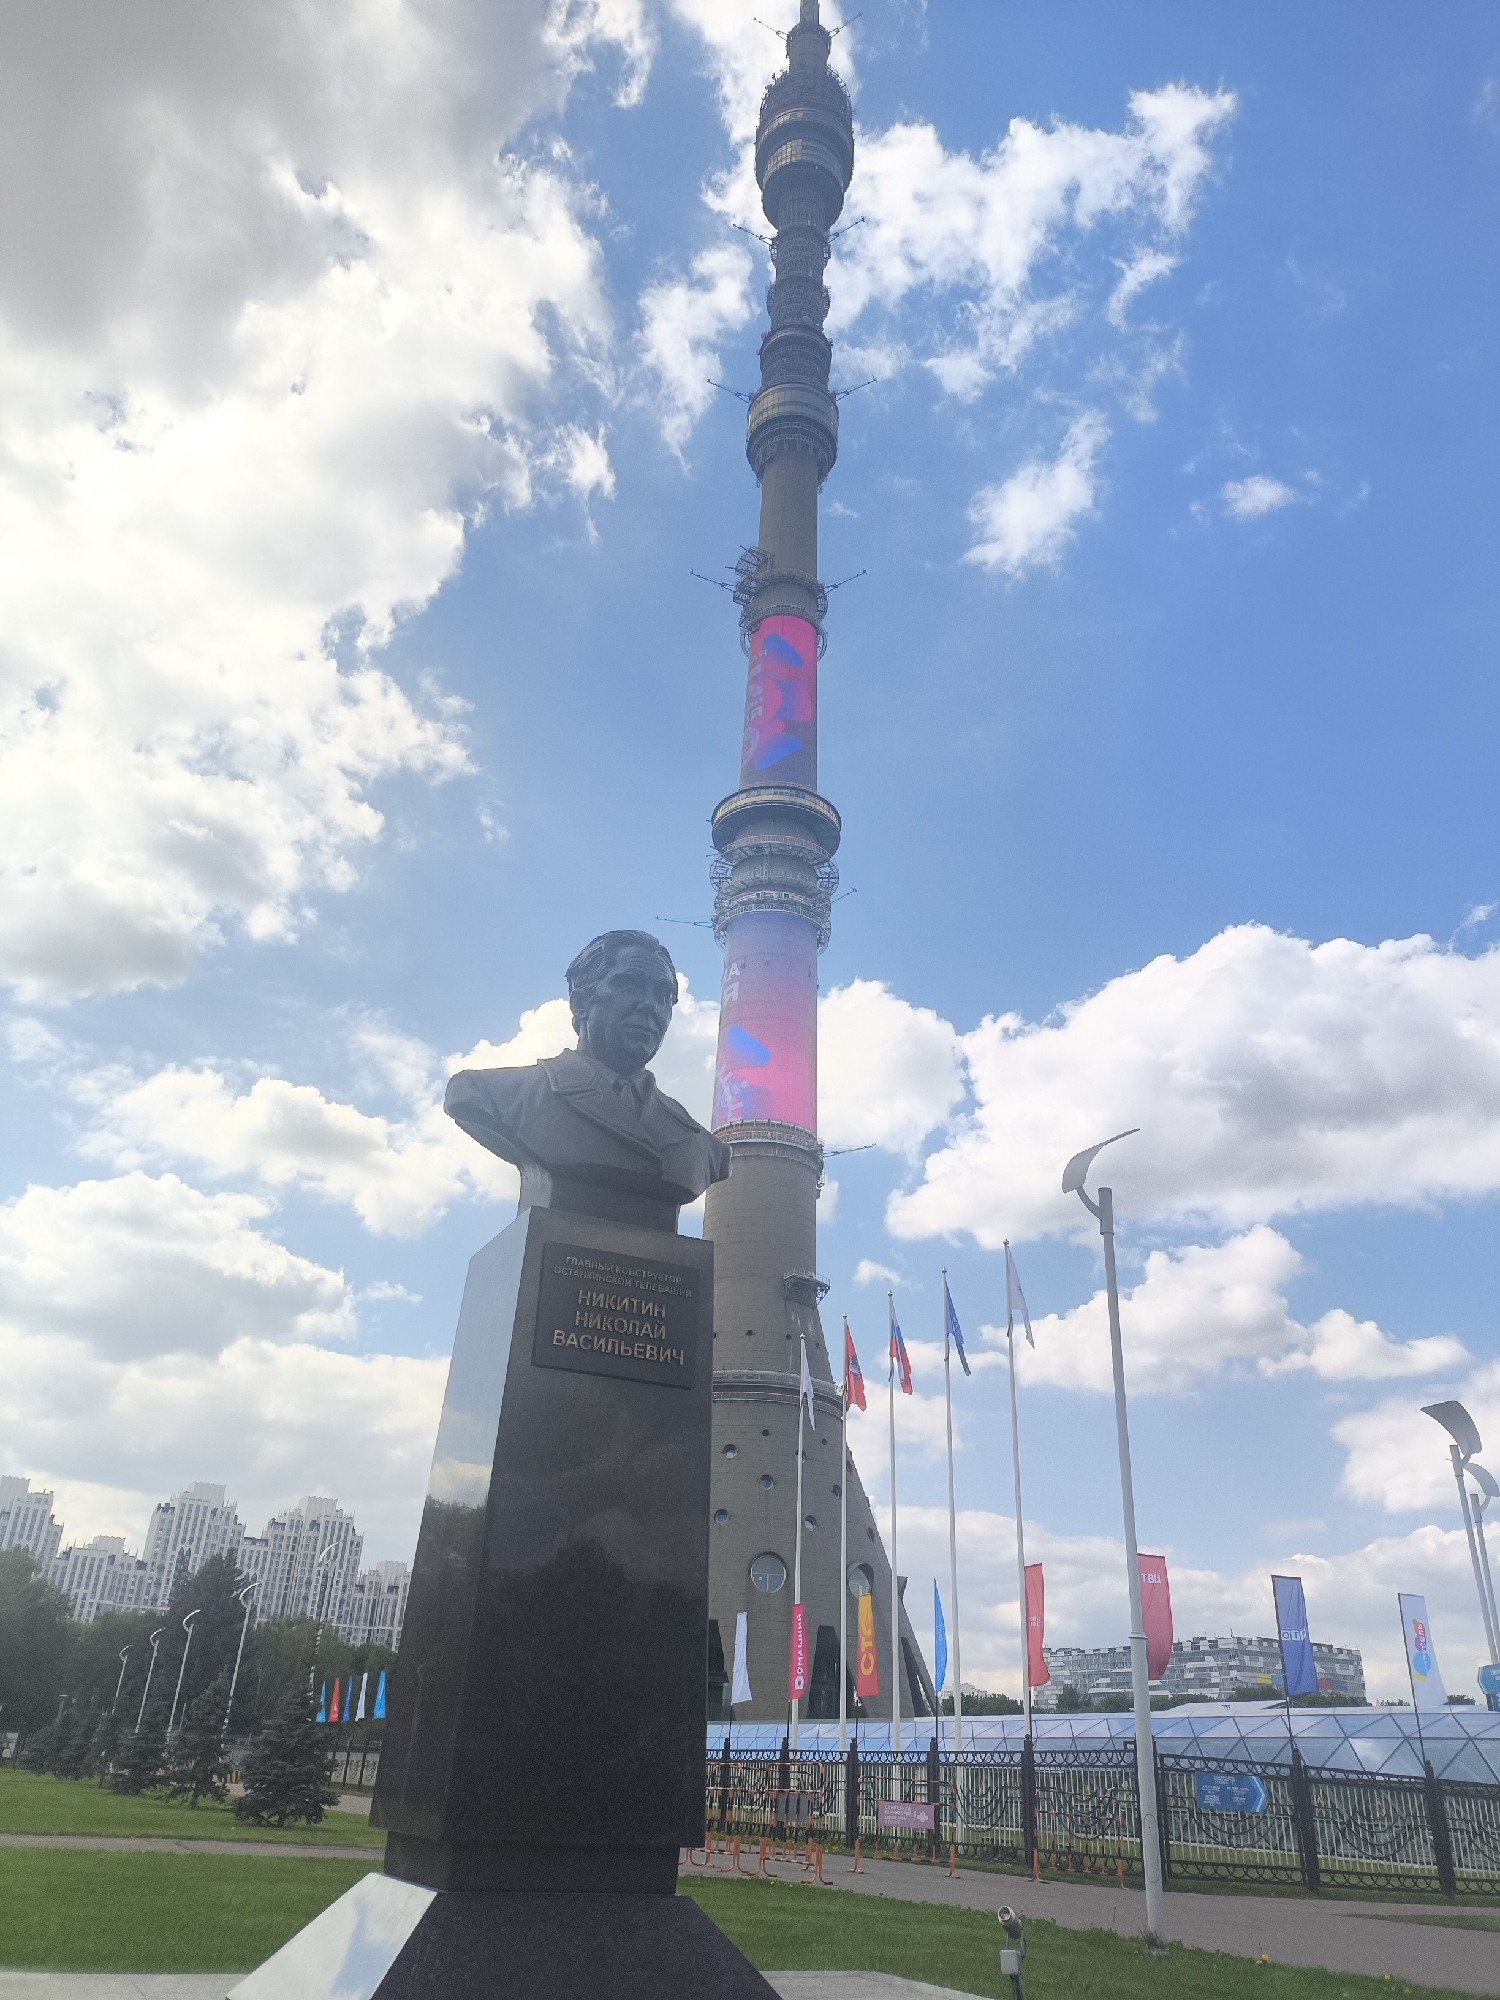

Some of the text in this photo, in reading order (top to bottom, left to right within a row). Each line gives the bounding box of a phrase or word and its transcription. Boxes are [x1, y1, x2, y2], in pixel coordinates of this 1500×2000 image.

[554, 1266, 692, 1298] ОСТАНКИНСКОЙ ТЕЛЕБАШНИ
[566, 1256, 682, 1284] ГЛАВНЫЙ КОНСТРУКТОР
[578, 1290, 666, 1318] НИКИТИН
[575, 1311, 666, 1340] НИКОЛАЙ
[553, 1329, 684, 1366] ВАСИЛЬЕВИЧ
